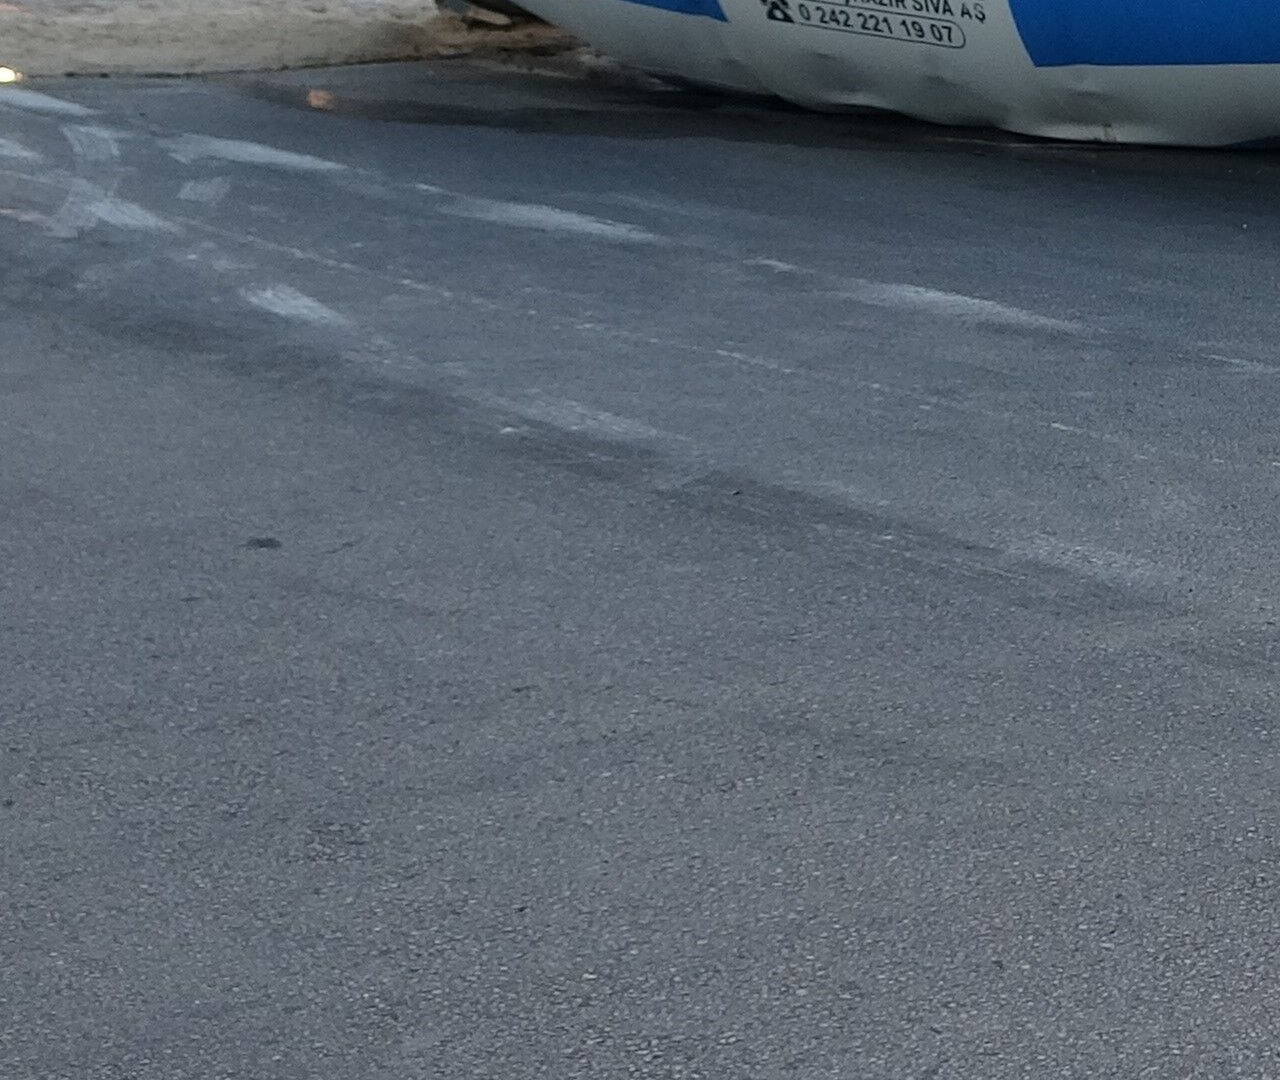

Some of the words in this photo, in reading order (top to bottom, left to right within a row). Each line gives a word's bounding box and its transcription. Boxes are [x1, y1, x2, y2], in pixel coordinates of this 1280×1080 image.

[800, 4, 811, 20] 0
[816, 6, 854, 28] 242
[857, 14, 891, 34] 221
[899, 20, 925, 38] 19
[932, 25, 954, 43] 07
